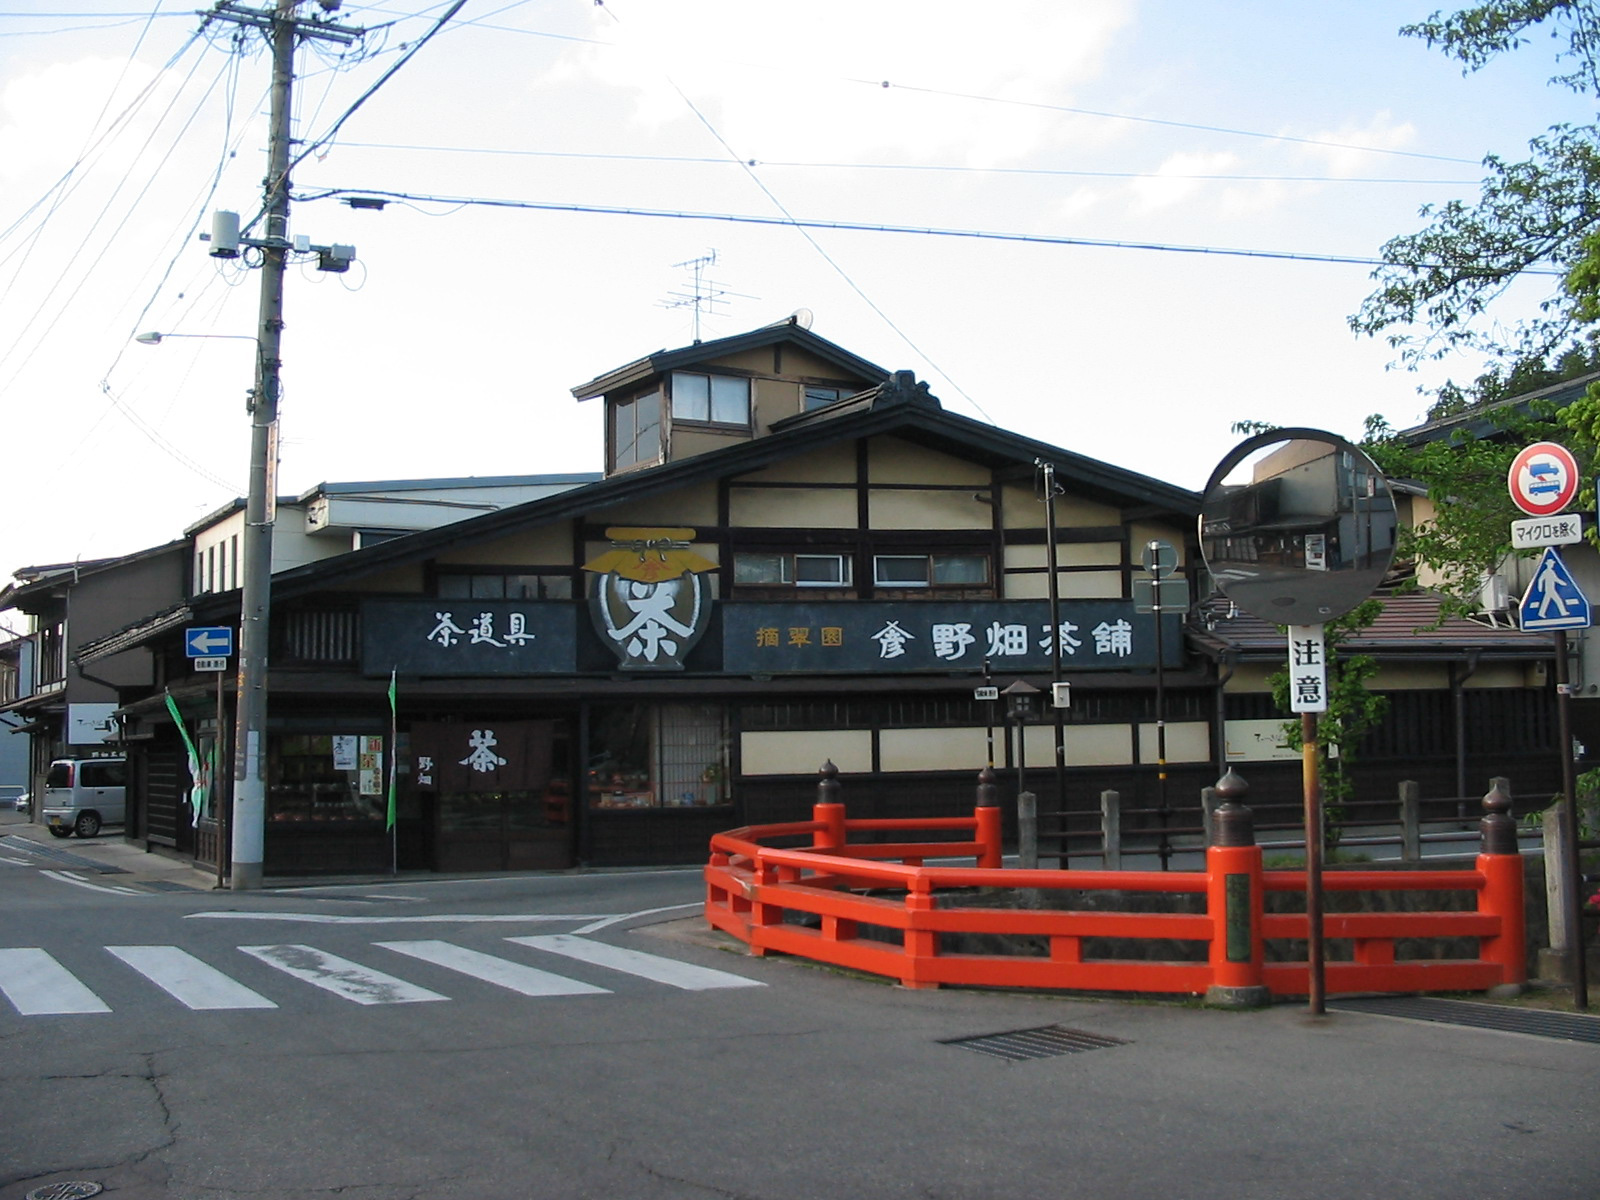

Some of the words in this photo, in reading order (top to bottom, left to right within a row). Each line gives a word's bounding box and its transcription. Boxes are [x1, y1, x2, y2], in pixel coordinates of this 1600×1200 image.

[1515, 522, 1577, 542] マイクロを除く
[427, 612, 536, 648] 茶道具
[607, 582, 695, 662] 茶
[1293, 639, 1322, 705] 注意
[417, 756, 434, 786] 野畑
[458, 729, 507, 773] 茶
